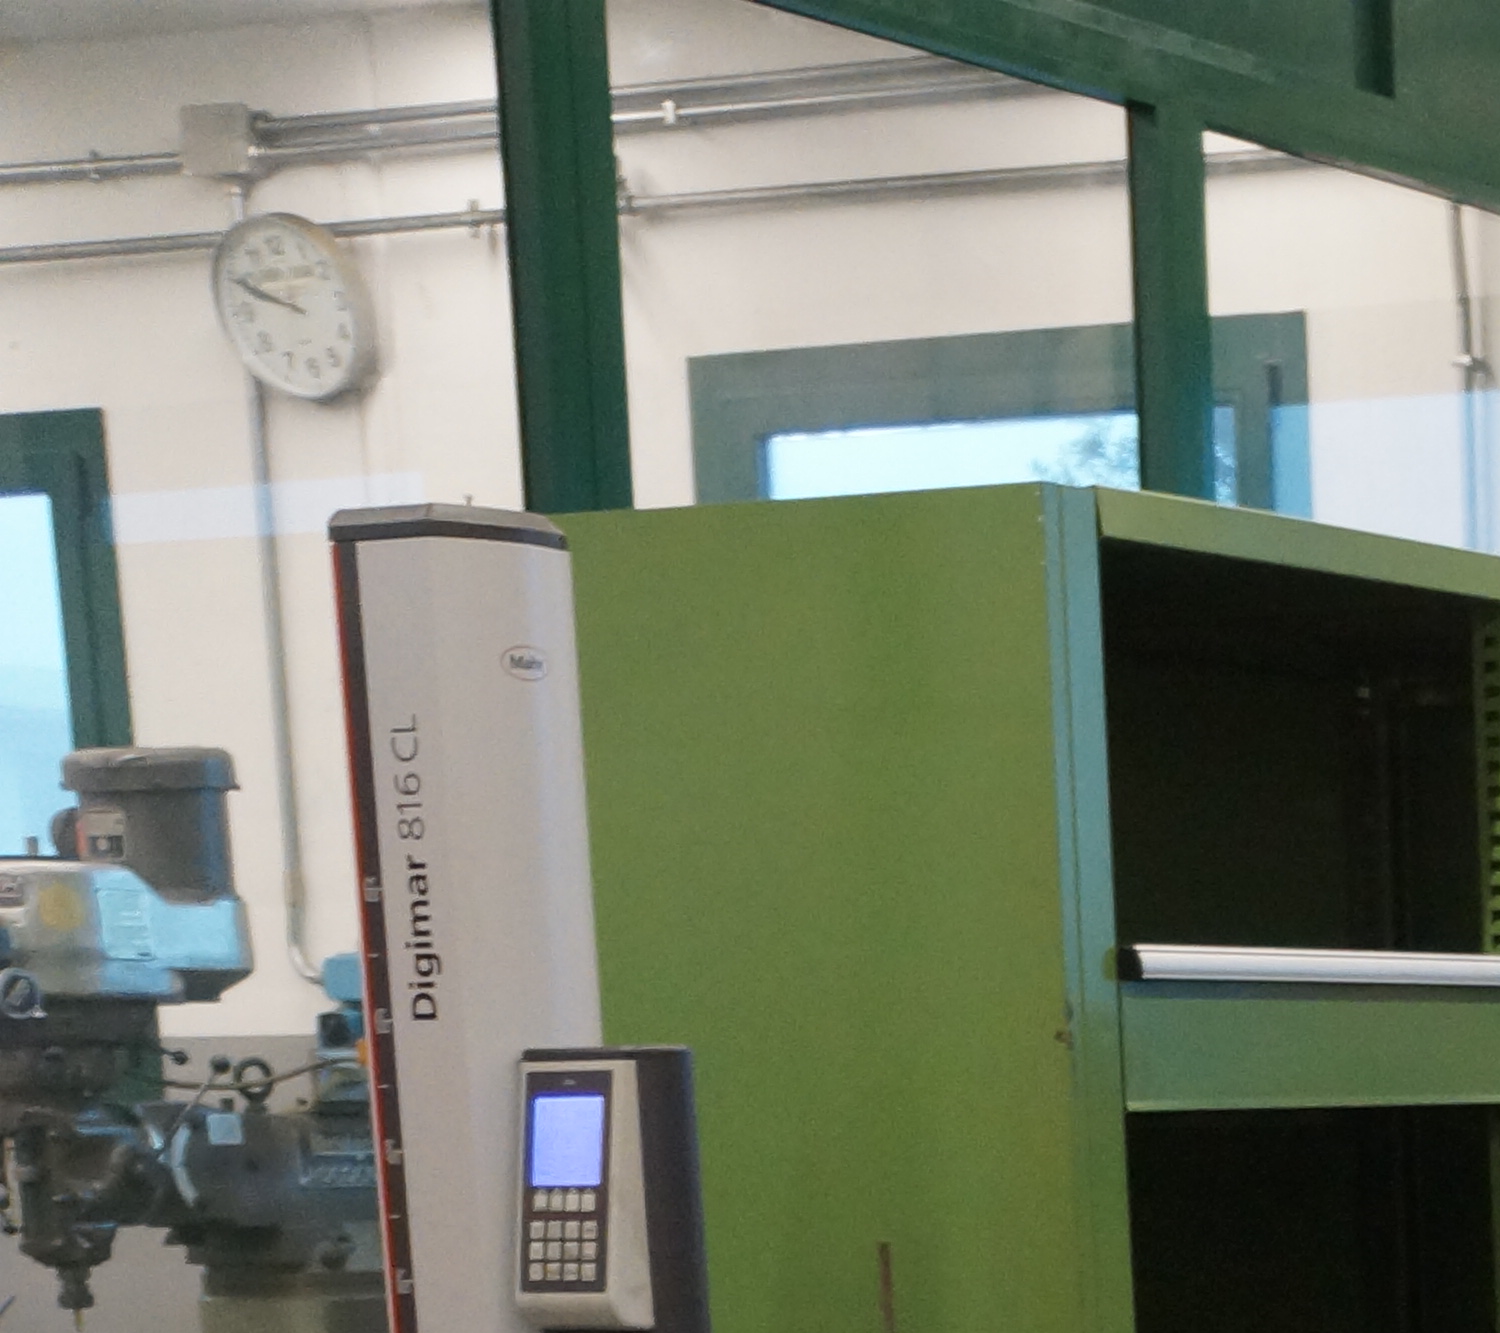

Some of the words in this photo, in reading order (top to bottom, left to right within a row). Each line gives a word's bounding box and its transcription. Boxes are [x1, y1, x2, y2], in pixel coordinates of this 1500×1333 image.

[389, 712, 419, 763] CL
[394, 771, 426, 841] 816
[404, 854, 443, 1021] Digimar
